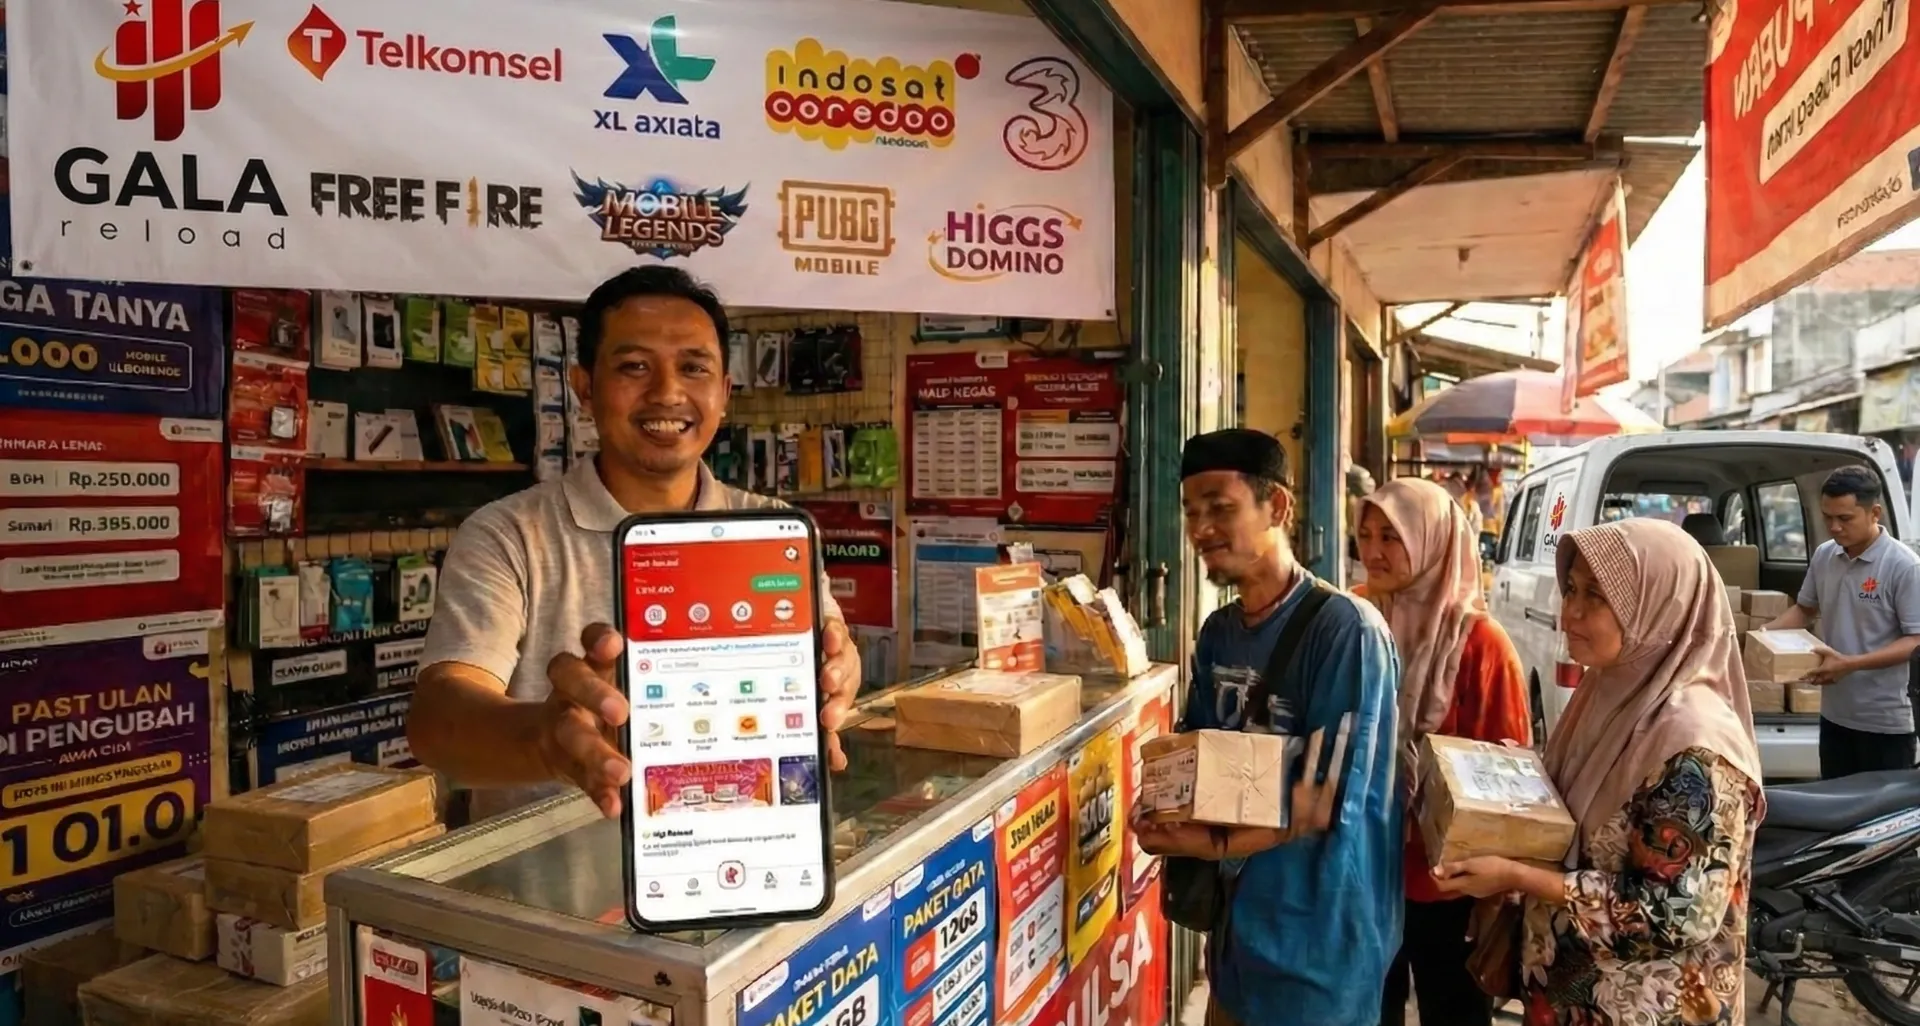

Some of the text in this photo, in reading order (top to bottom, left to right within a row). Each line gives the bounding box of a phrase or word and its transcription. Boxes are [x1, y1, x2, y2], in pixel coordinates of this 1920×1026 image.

[356, 30, 562, 82] Telkomsel
[593, 110, 721, 139] XL axiata
[54, 147, 288, 217] GALA
[310, 171, 544, 229] FREE FIRE
[602, 189, 725, 222] MOBILE
[796, 193, 881, 243] PUBG
[61, 219, 286, 250] reload
[602, 216, 724, 244] LEGENDS
[794, 257, 880, 276] MOBILE
[946, 246, 1065, 275] DOMINO
[66, 288, 191, 332] TANYA
[69, 471, 170, 489] Rp.250.000
[12, 681, 172, 725] PAST ULAN
[26, 702, 196, 752] PENGUBAH
[903, 886, 951, 939] PAKET
[831, 942, 879, 997] DATA
[1054, 911, 1153, 1026] ULSA
